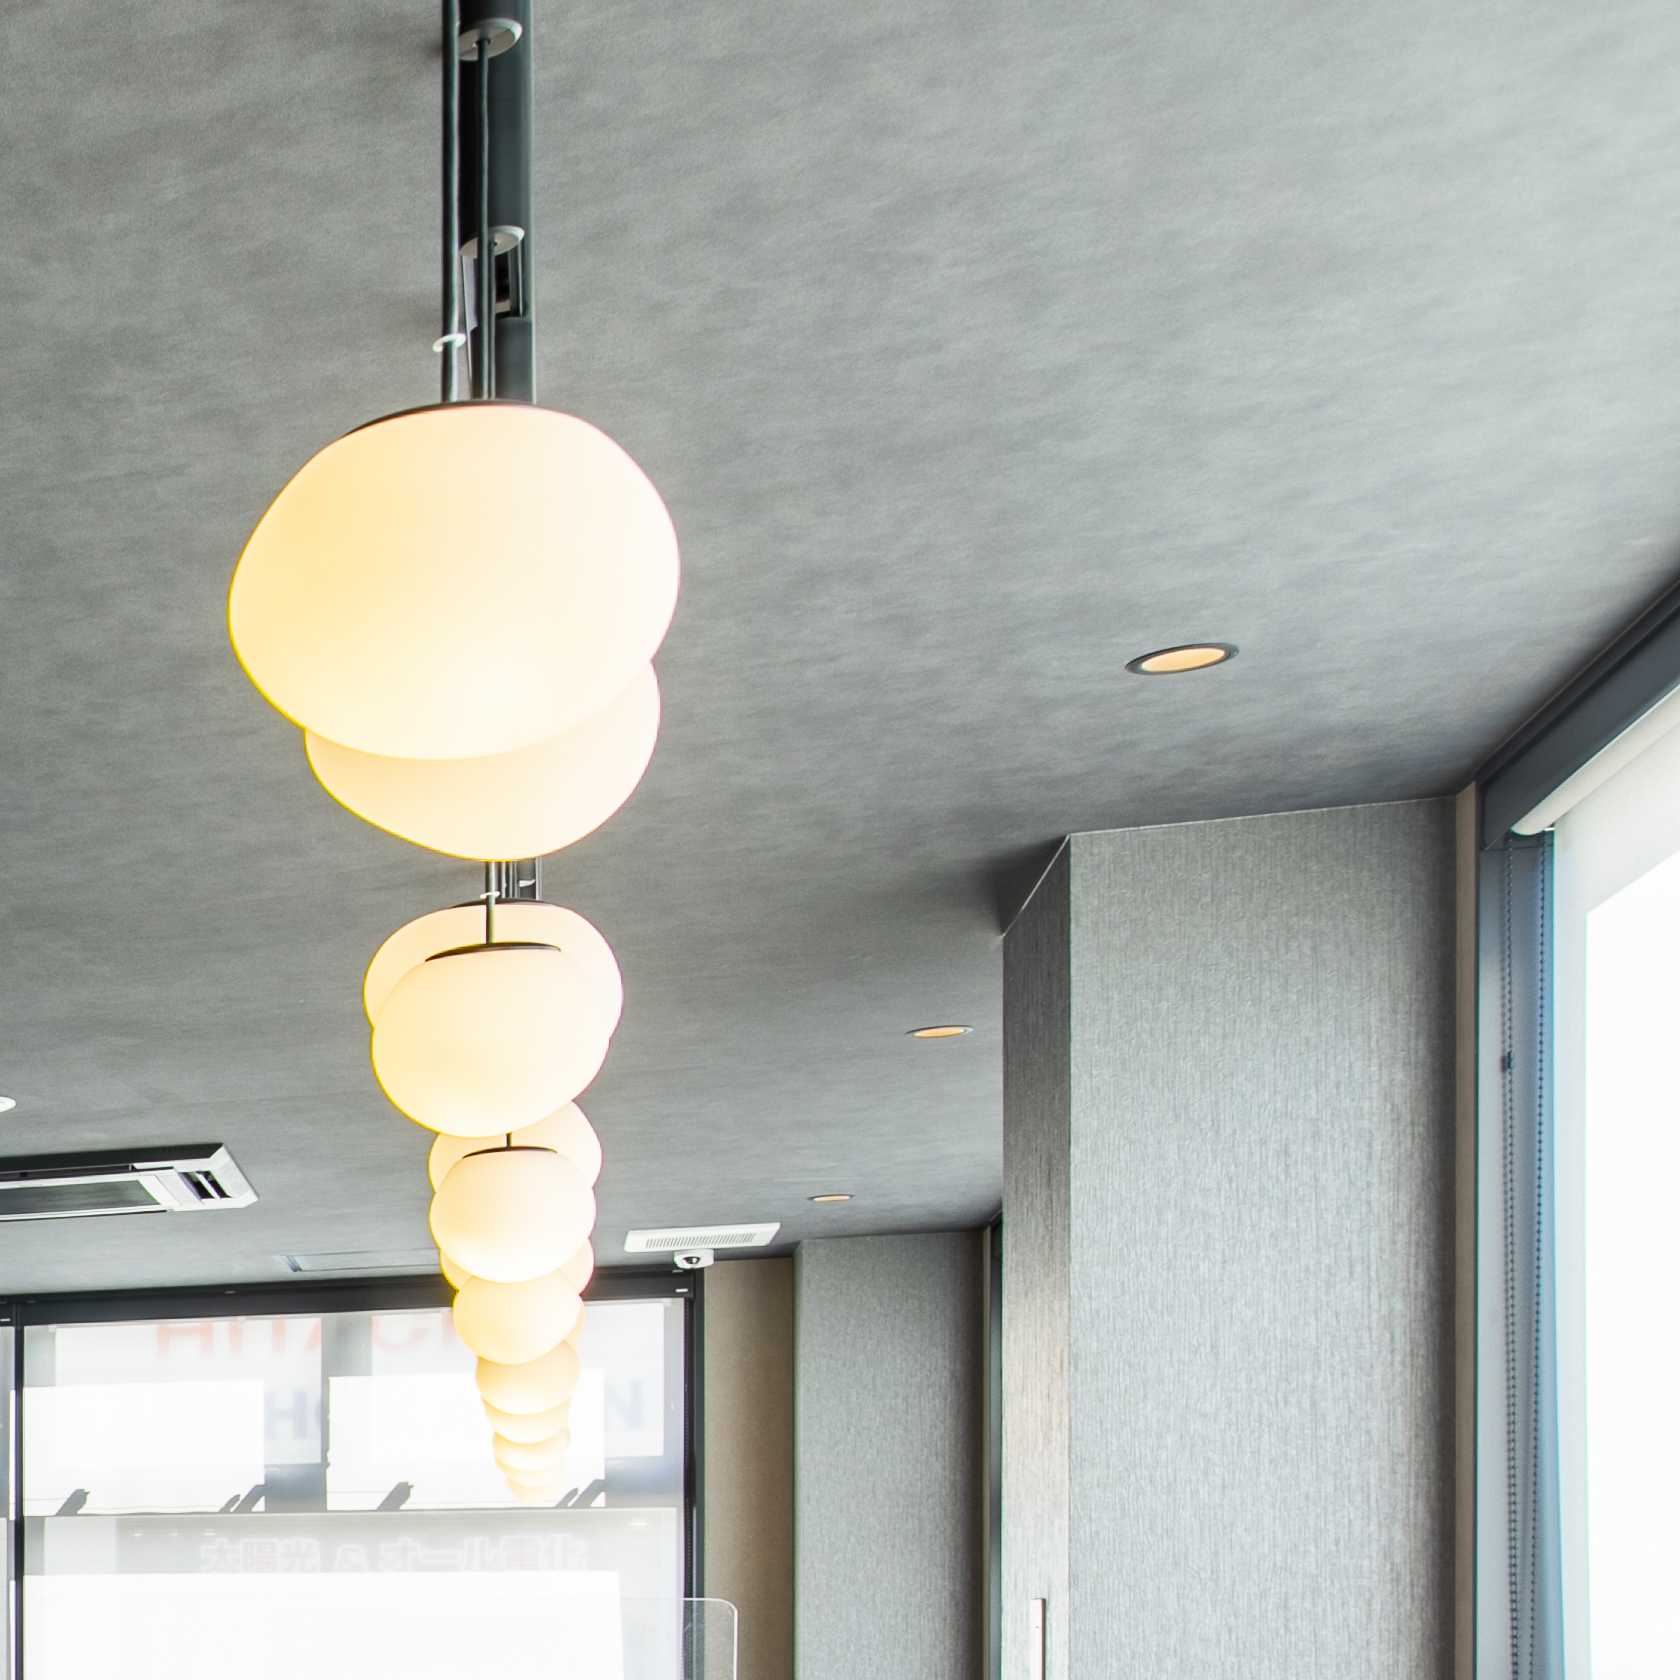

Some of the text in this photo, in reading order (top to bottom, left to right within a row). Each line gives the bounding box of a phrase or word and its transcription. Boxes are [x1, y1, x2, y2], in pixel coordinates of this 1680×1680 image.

[201, 1538, 320, 1572] 太陽光
[379, 1534, 588, 1571] オール電化
